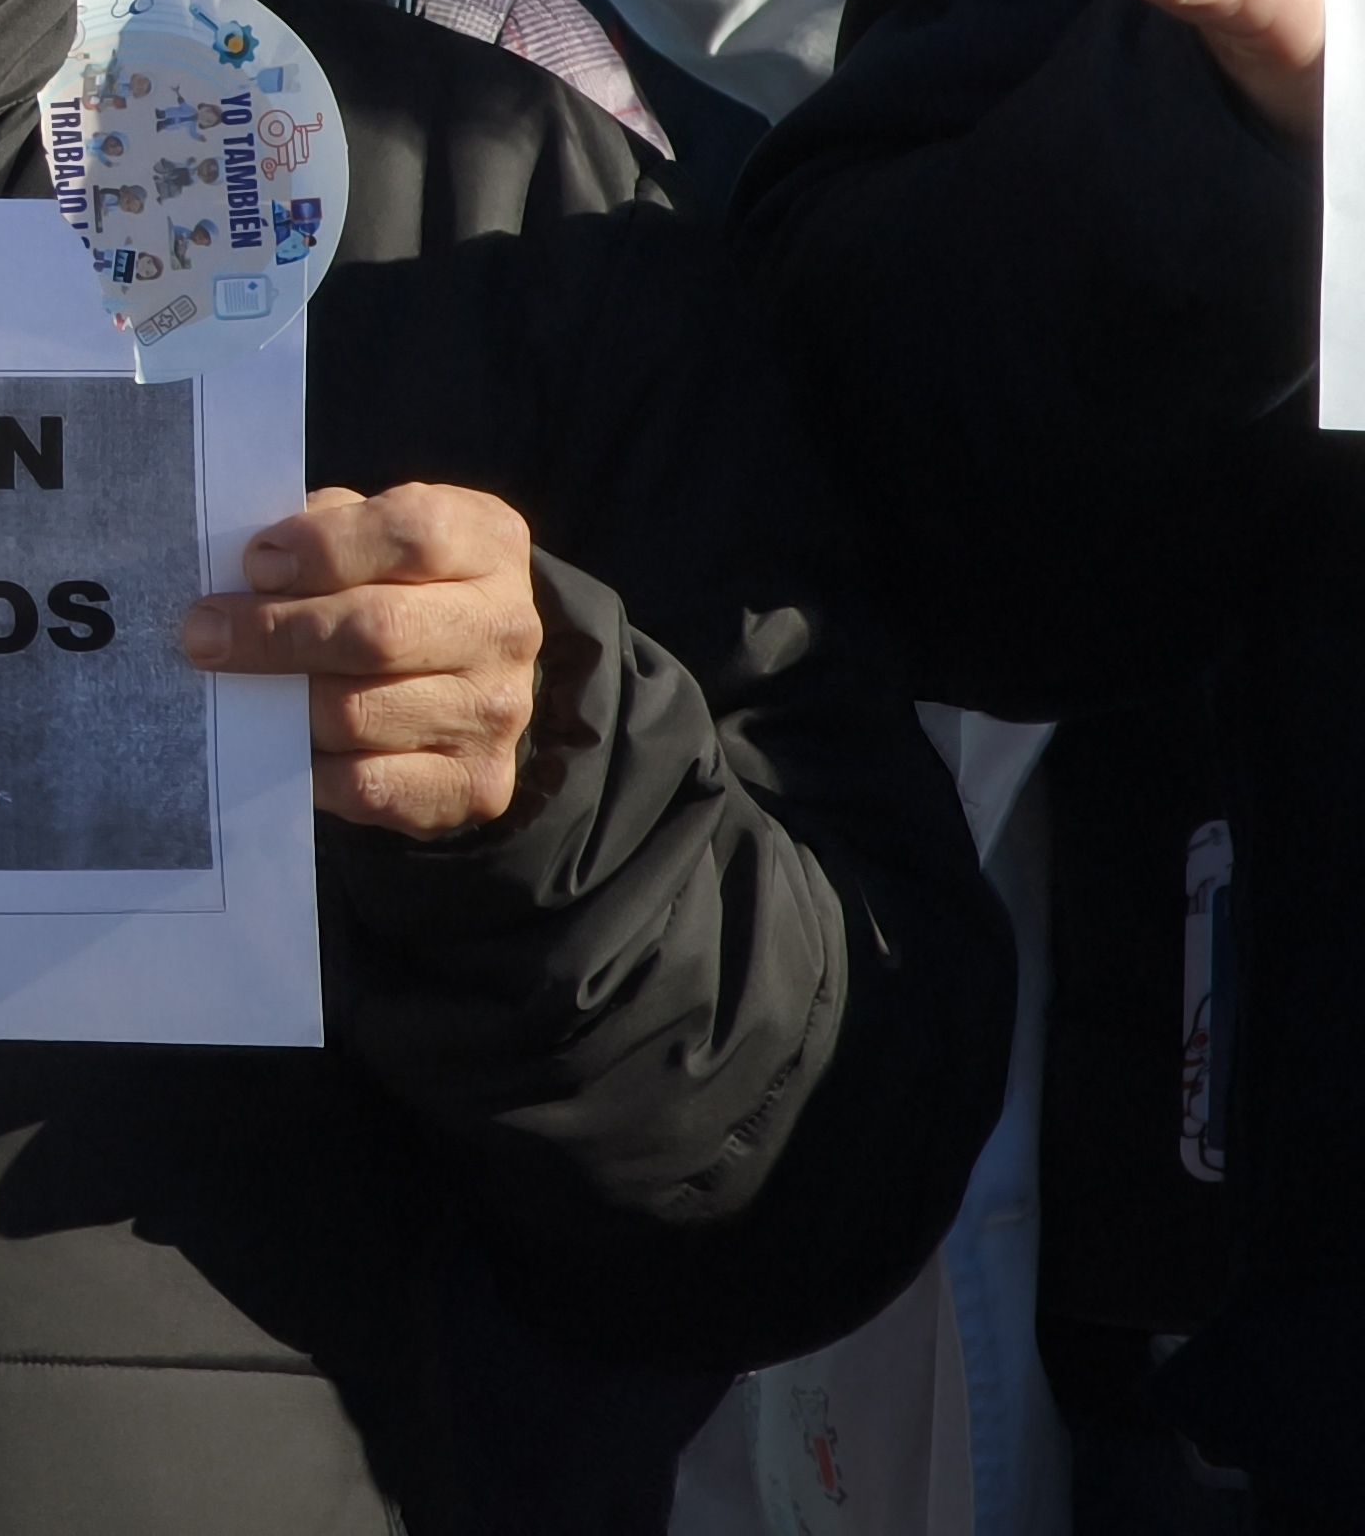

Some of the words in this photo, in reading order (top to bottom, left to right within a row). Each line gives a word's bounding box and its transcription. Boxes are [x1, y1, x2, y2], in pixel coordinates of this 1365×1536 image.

[50, 97, 88, 214] TRABAJO
[220, 92, 252, 126] YO
[223, 134, 269, 249] TAMBIÉN
